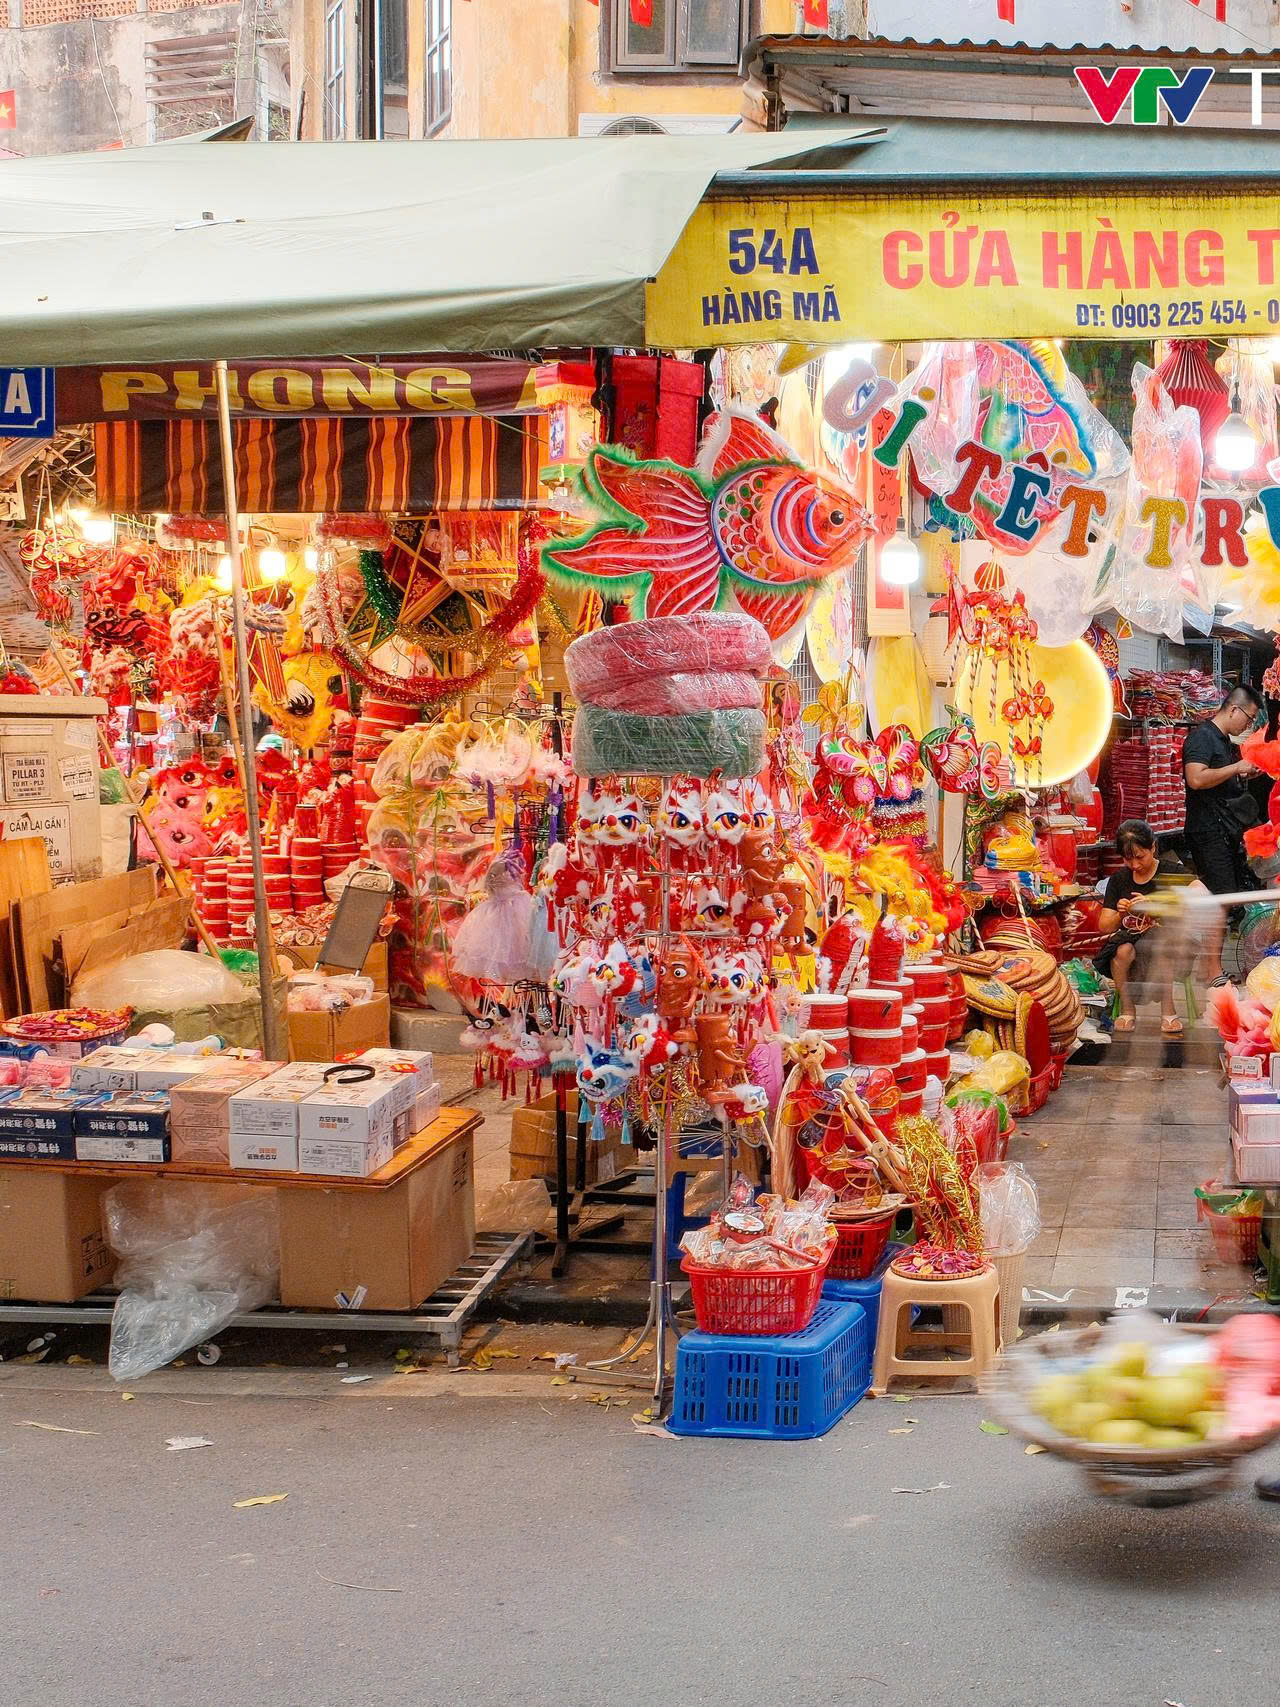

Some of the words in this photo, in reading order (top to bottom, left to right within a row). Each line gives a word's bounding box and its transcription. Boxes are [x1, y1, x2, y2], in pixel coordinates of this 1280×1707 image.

[729, 227, 820, 275] 54A
[882, 211, 1019, 289] CỬA
[1042, 217, 1225, 290] HÀNG
[701, 289, 782, 326] HÀNG
[793, 289, 841, 324] MÃ
[1076, 303, 1106, 327] ĐT:
[1111, 303, 1161, 329] 0903
[1167, 301, 1204, 327] 225
[1210, 300, 1247, 325] 454
[101, 367, 472, 413] PHONG
[12, 769, 38, 779] PILLAR
[40, 769, 45, 778] 3
